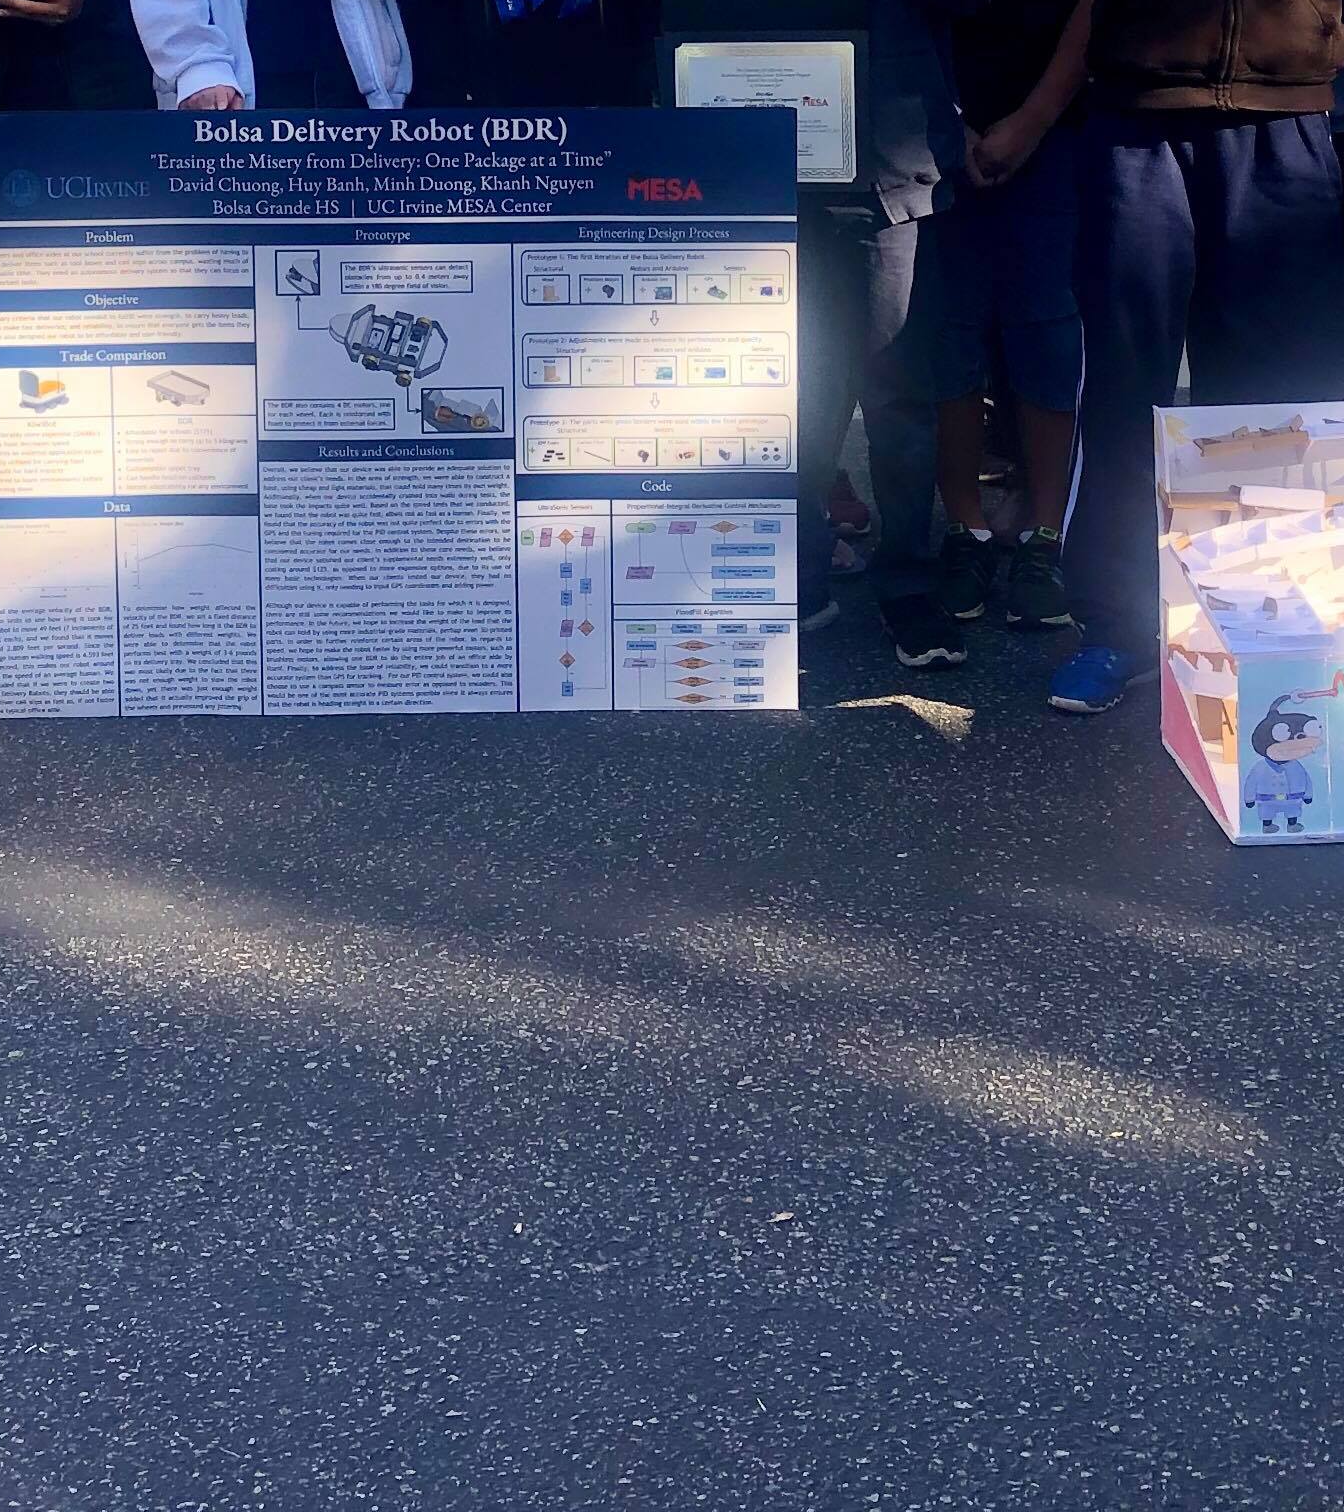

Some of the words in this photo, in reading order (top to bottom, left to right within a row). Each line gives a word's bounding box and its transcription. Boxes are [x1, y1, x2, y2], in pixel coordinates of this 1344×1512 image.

[802, 97, 828, 107] MESA
[194, 118, 265, 142] Bolsa
[271, 118, 383, 148] Delivery
[388, 117, 473, 141] Robot
[479, 117, 568, 147] (BDR)
[218, 153, 244, 169] the
[247, 152, 302, 173] Misery
[305, 152, 345, 168] from
[348, 151, 420, 172] Delivery:
[423, 151, 459, 167] One
[462, 150, 526, 171] Package
[529, 150, 544, 166] at
[547, 154, 557, 166] a
[169, 176, 214, 192] David
[217, 176, 284, 196] Chuong,
[287, 176, 321, 196] Huy
[324, 176, 369, 196] Banh,
[372, 176, 414, 192] Minh
[417, 175, 476, 196] Duong,
[479, 175, 531, 191] Khanh
[534, 175, 594, 195] Nguyen
[624, 176, 702, 202] MESA
[213, 200, 252, 213] Bolsa
[255, 199, 311, 213] Grande
[316, 199, 339, 212] HS
[368, 199, 394, 212] UC
[398, 199, 443, 212] Irvine
[447, 198, 496, 212] MESA
[499, 198, 552, 212] Center
[85, 231, 134, 243] Problem
[355, 230, 411, 243] Prototype
[578, 226, 645, 242] Engineering
[647, 226, 686, 241] Design
[688, 226, 730, 238] Process
[84, 294, 139, 307] Objective
[59, 349, 93, 362] Trade
[95, 348, 166, 364] Comparison
[319, 446, 358, 459] Results
[360, 446, 382, 459] and
[384, 446, 454, 459] Conclusions
[641, 480, 672, 492] Code
[104, 500, 131, 513] Data
